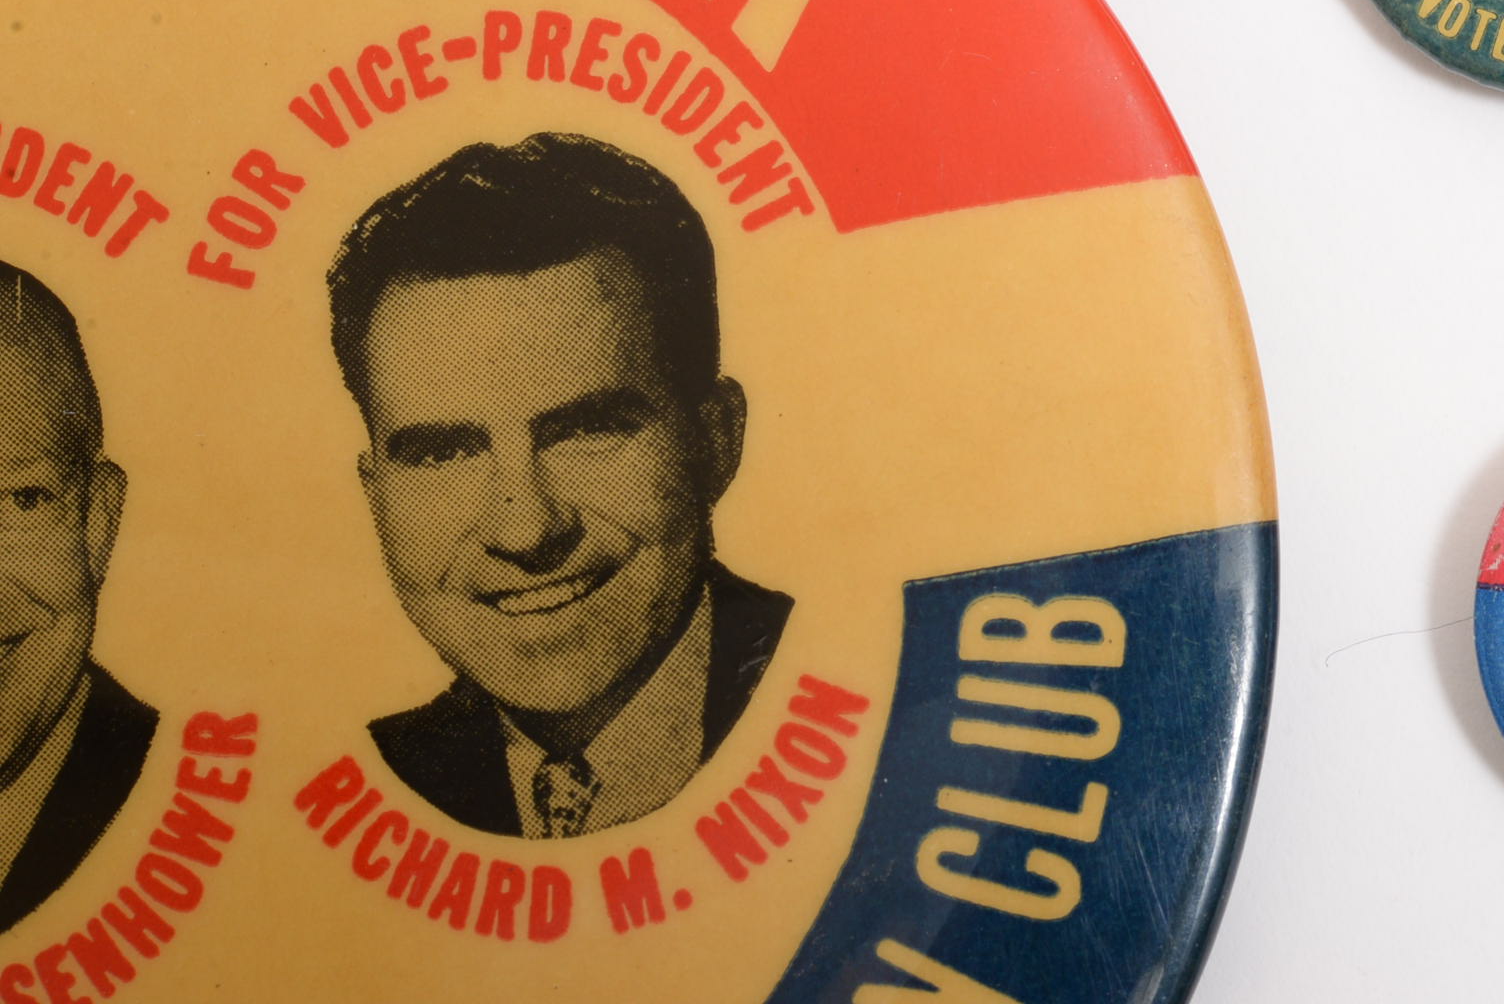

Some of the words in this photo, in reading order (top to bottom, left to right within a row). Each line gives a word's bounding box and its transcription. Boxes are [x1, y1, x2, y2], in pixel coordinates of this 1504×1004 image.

[187, 149, 305, 290] FOR
[288, 10, 816, 233] VICE-PRESIDENT
[292, 754, 574, 943] RICHARD
[601, 846, 693, 935] M.
[695, 673, 871, 883] NIXON
[916, 591, 1128, 922] CLUB
